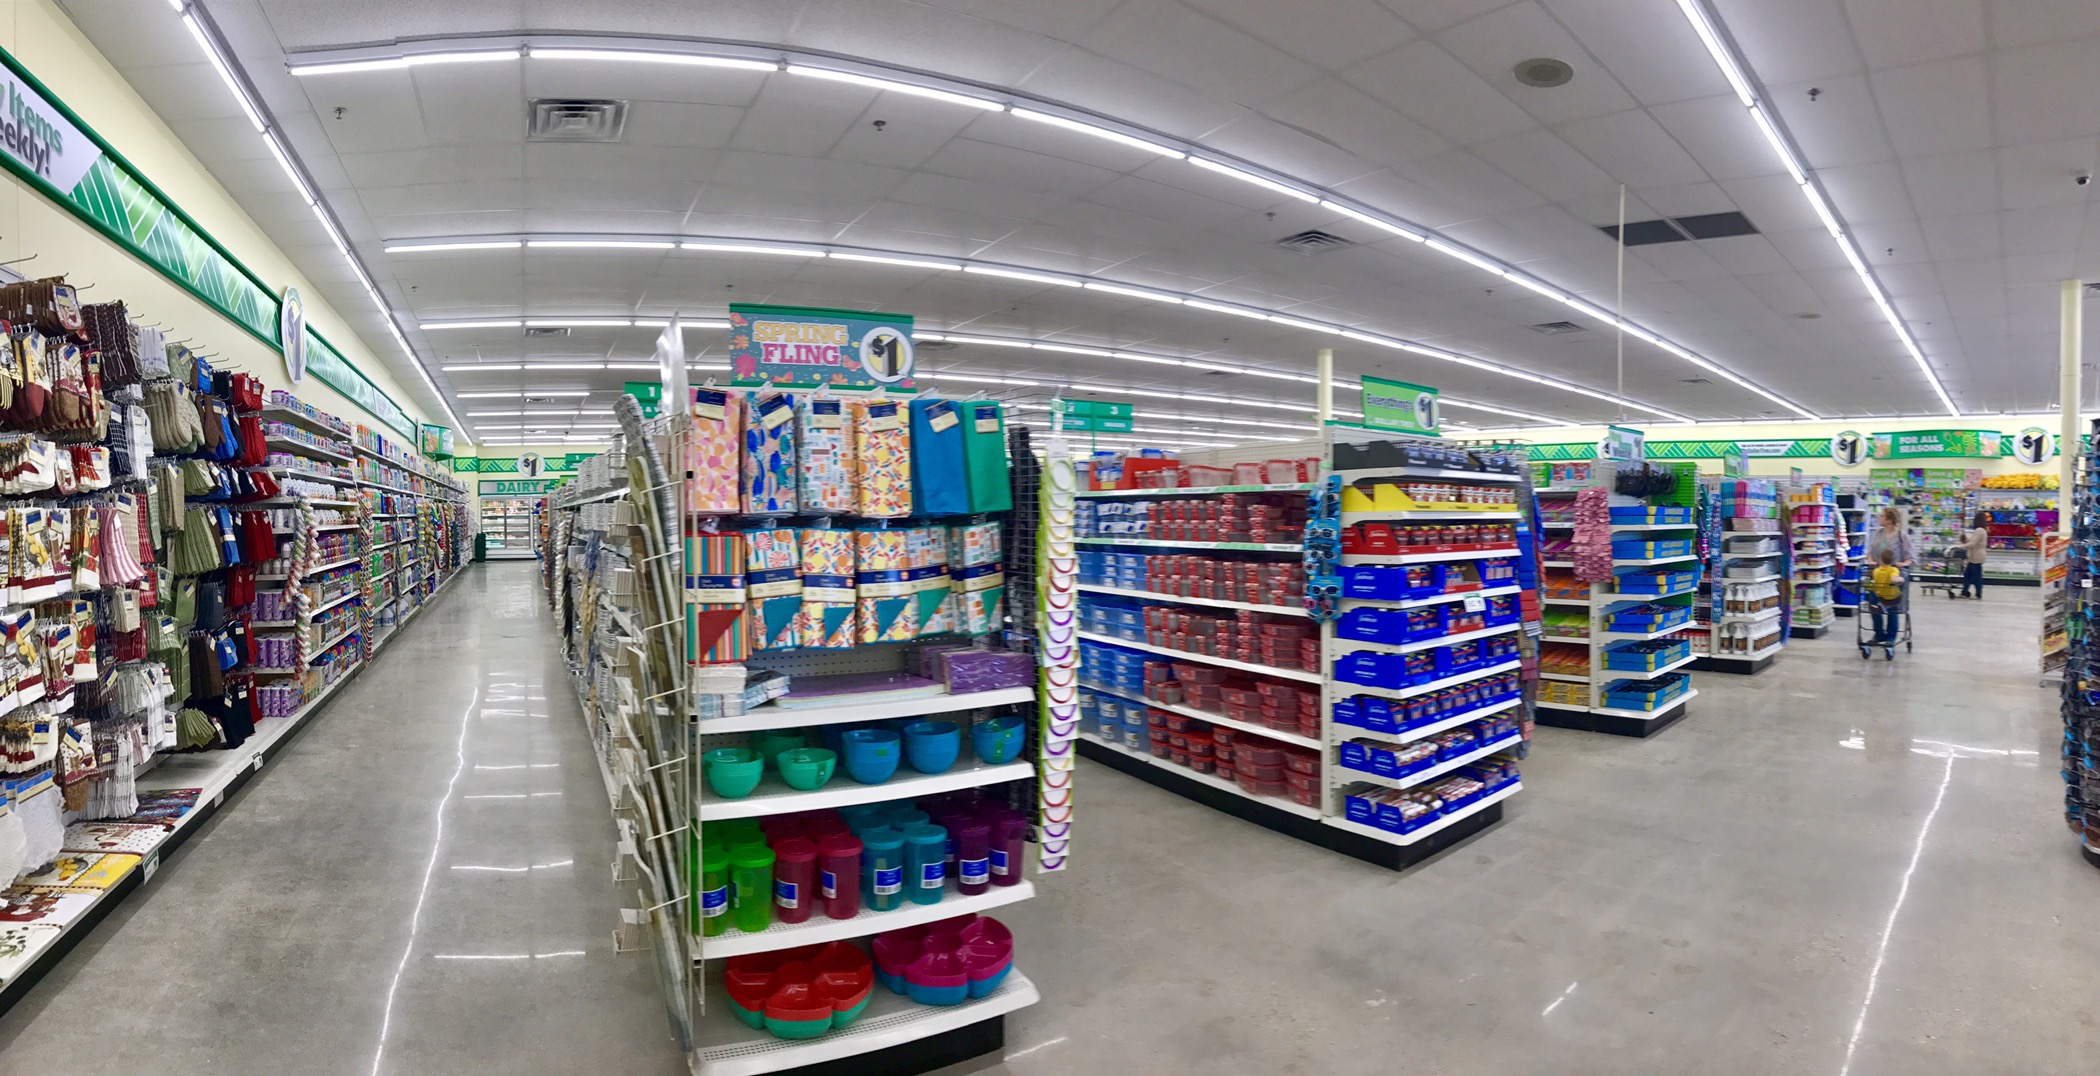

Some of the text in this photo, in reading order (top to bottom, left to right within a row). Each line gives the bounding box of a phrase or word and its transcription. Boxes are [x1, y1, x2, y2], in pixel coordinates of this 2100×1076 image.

[9, 80, 62, 154] Items
[287, 305, 302, 381] $1
[753, 321, 849, 346] SPRING
[761, 342, 841, 366] FLING
[870, 335, 902, 378] $1
[648, 386, 655, 397] 1
[1110, 405, 1119, 415] 3
[1418, 396, 1433, 428] $1
[1838, 437, 1858, 464] $1
[1899, 434, 1939, 444] FOR ALL
[1899, 444, 1945, 454] SEASONS
[2022, 434, 2045, 463] $1
[523, 457, 538, 477] $1
[496, 481, 539, 493] DAIRY
